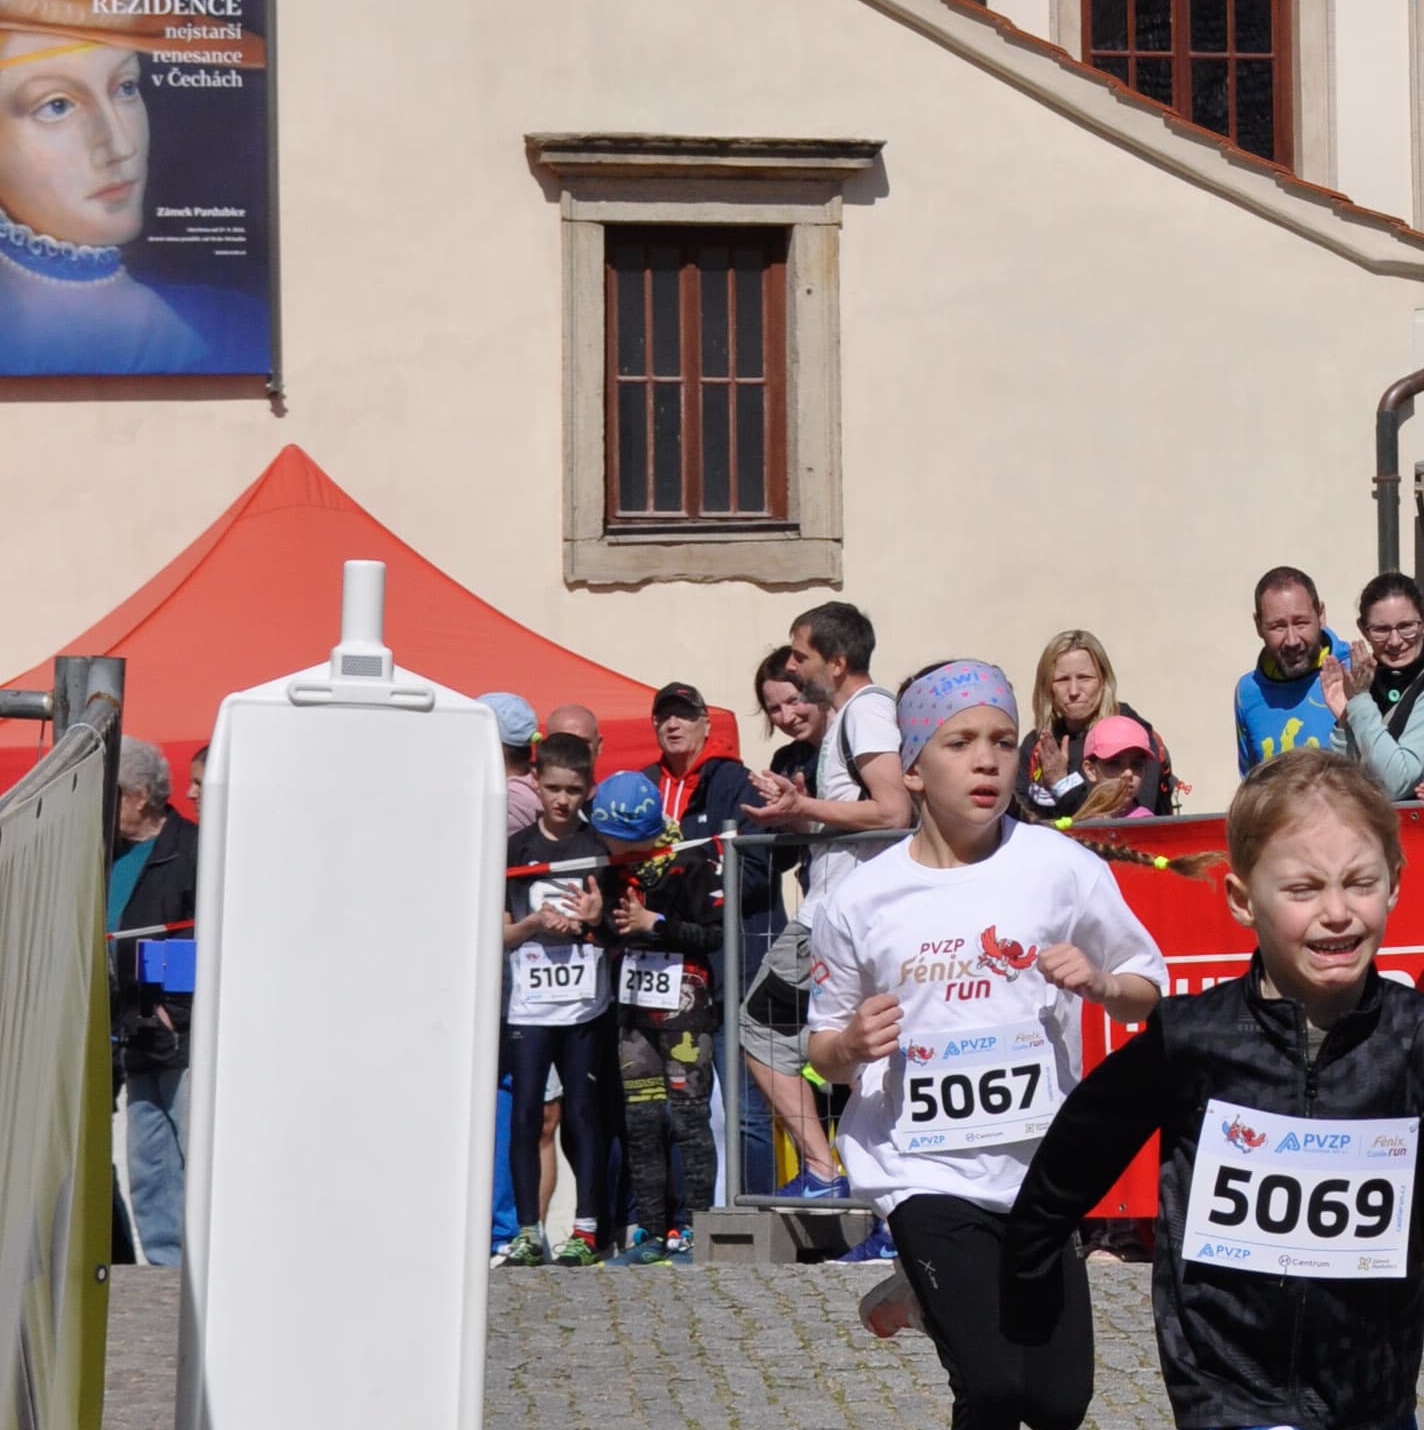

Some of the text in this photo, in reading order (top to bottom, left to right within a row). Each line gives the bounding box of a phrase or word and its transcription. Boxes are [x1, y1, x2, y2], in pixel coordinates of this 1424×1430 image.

[165, 23, 242, 43] nejstarší
[152, 50, 243, 64] renesance
[151, 68, 243, 88] v Čechách
[919, 938, 965, 955] PVZP
[529, 965, 585, 988] 5107
[895, 953, 985, 988] Fénix
[626, 969, 671, 994] 2138
[945, 979, 991, 1002] run
[960, 1036, 997, 1052] PVZP
[910, 1063, 1042, 1123] 5067
[920, 1135, 945, 1147] PVZP
[1303, 1132, 1351, 1149] PVZP
[1388, 1147, 1407, 1157] run
[1208, 1164, 1395, 1239] 5069
[1216, 1244, 1251, 1259] PVZP
